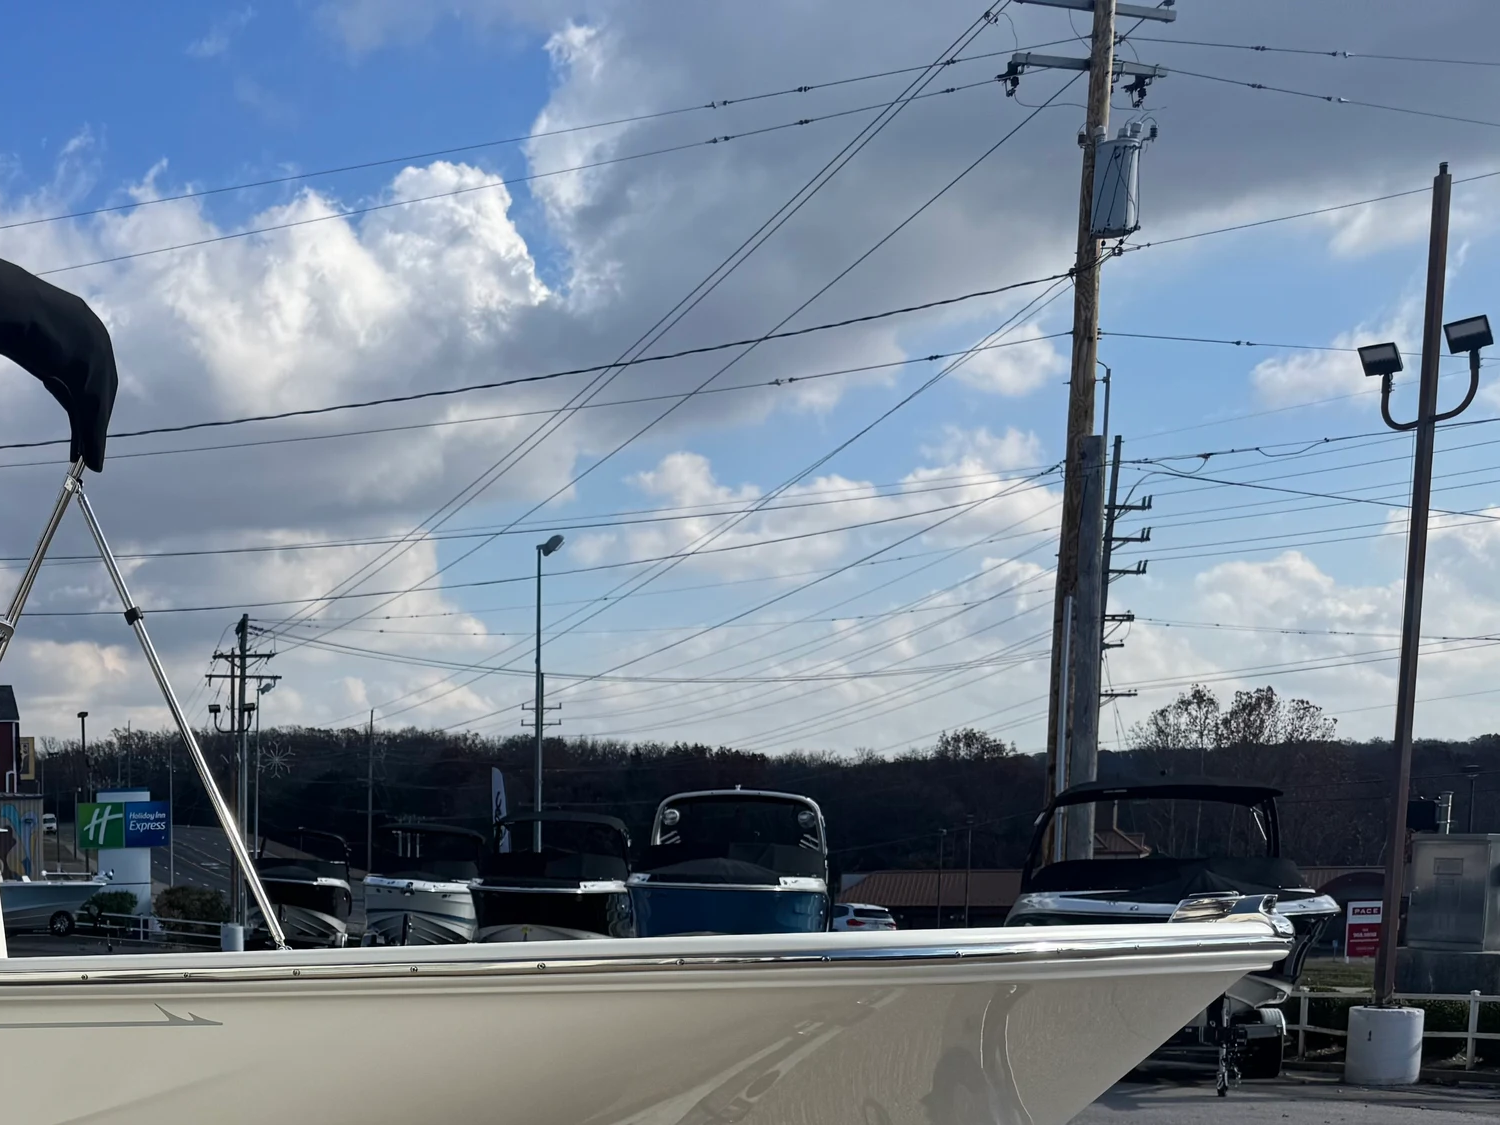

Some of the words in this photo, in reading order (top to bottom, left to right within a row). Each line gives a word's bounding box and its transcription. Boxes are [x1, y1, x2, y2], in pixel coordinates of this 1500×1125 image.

[129, 811, 155, 821] Holiday
[155, 811, 166, 819] Inn
[129, 820, 166, 832] Express
